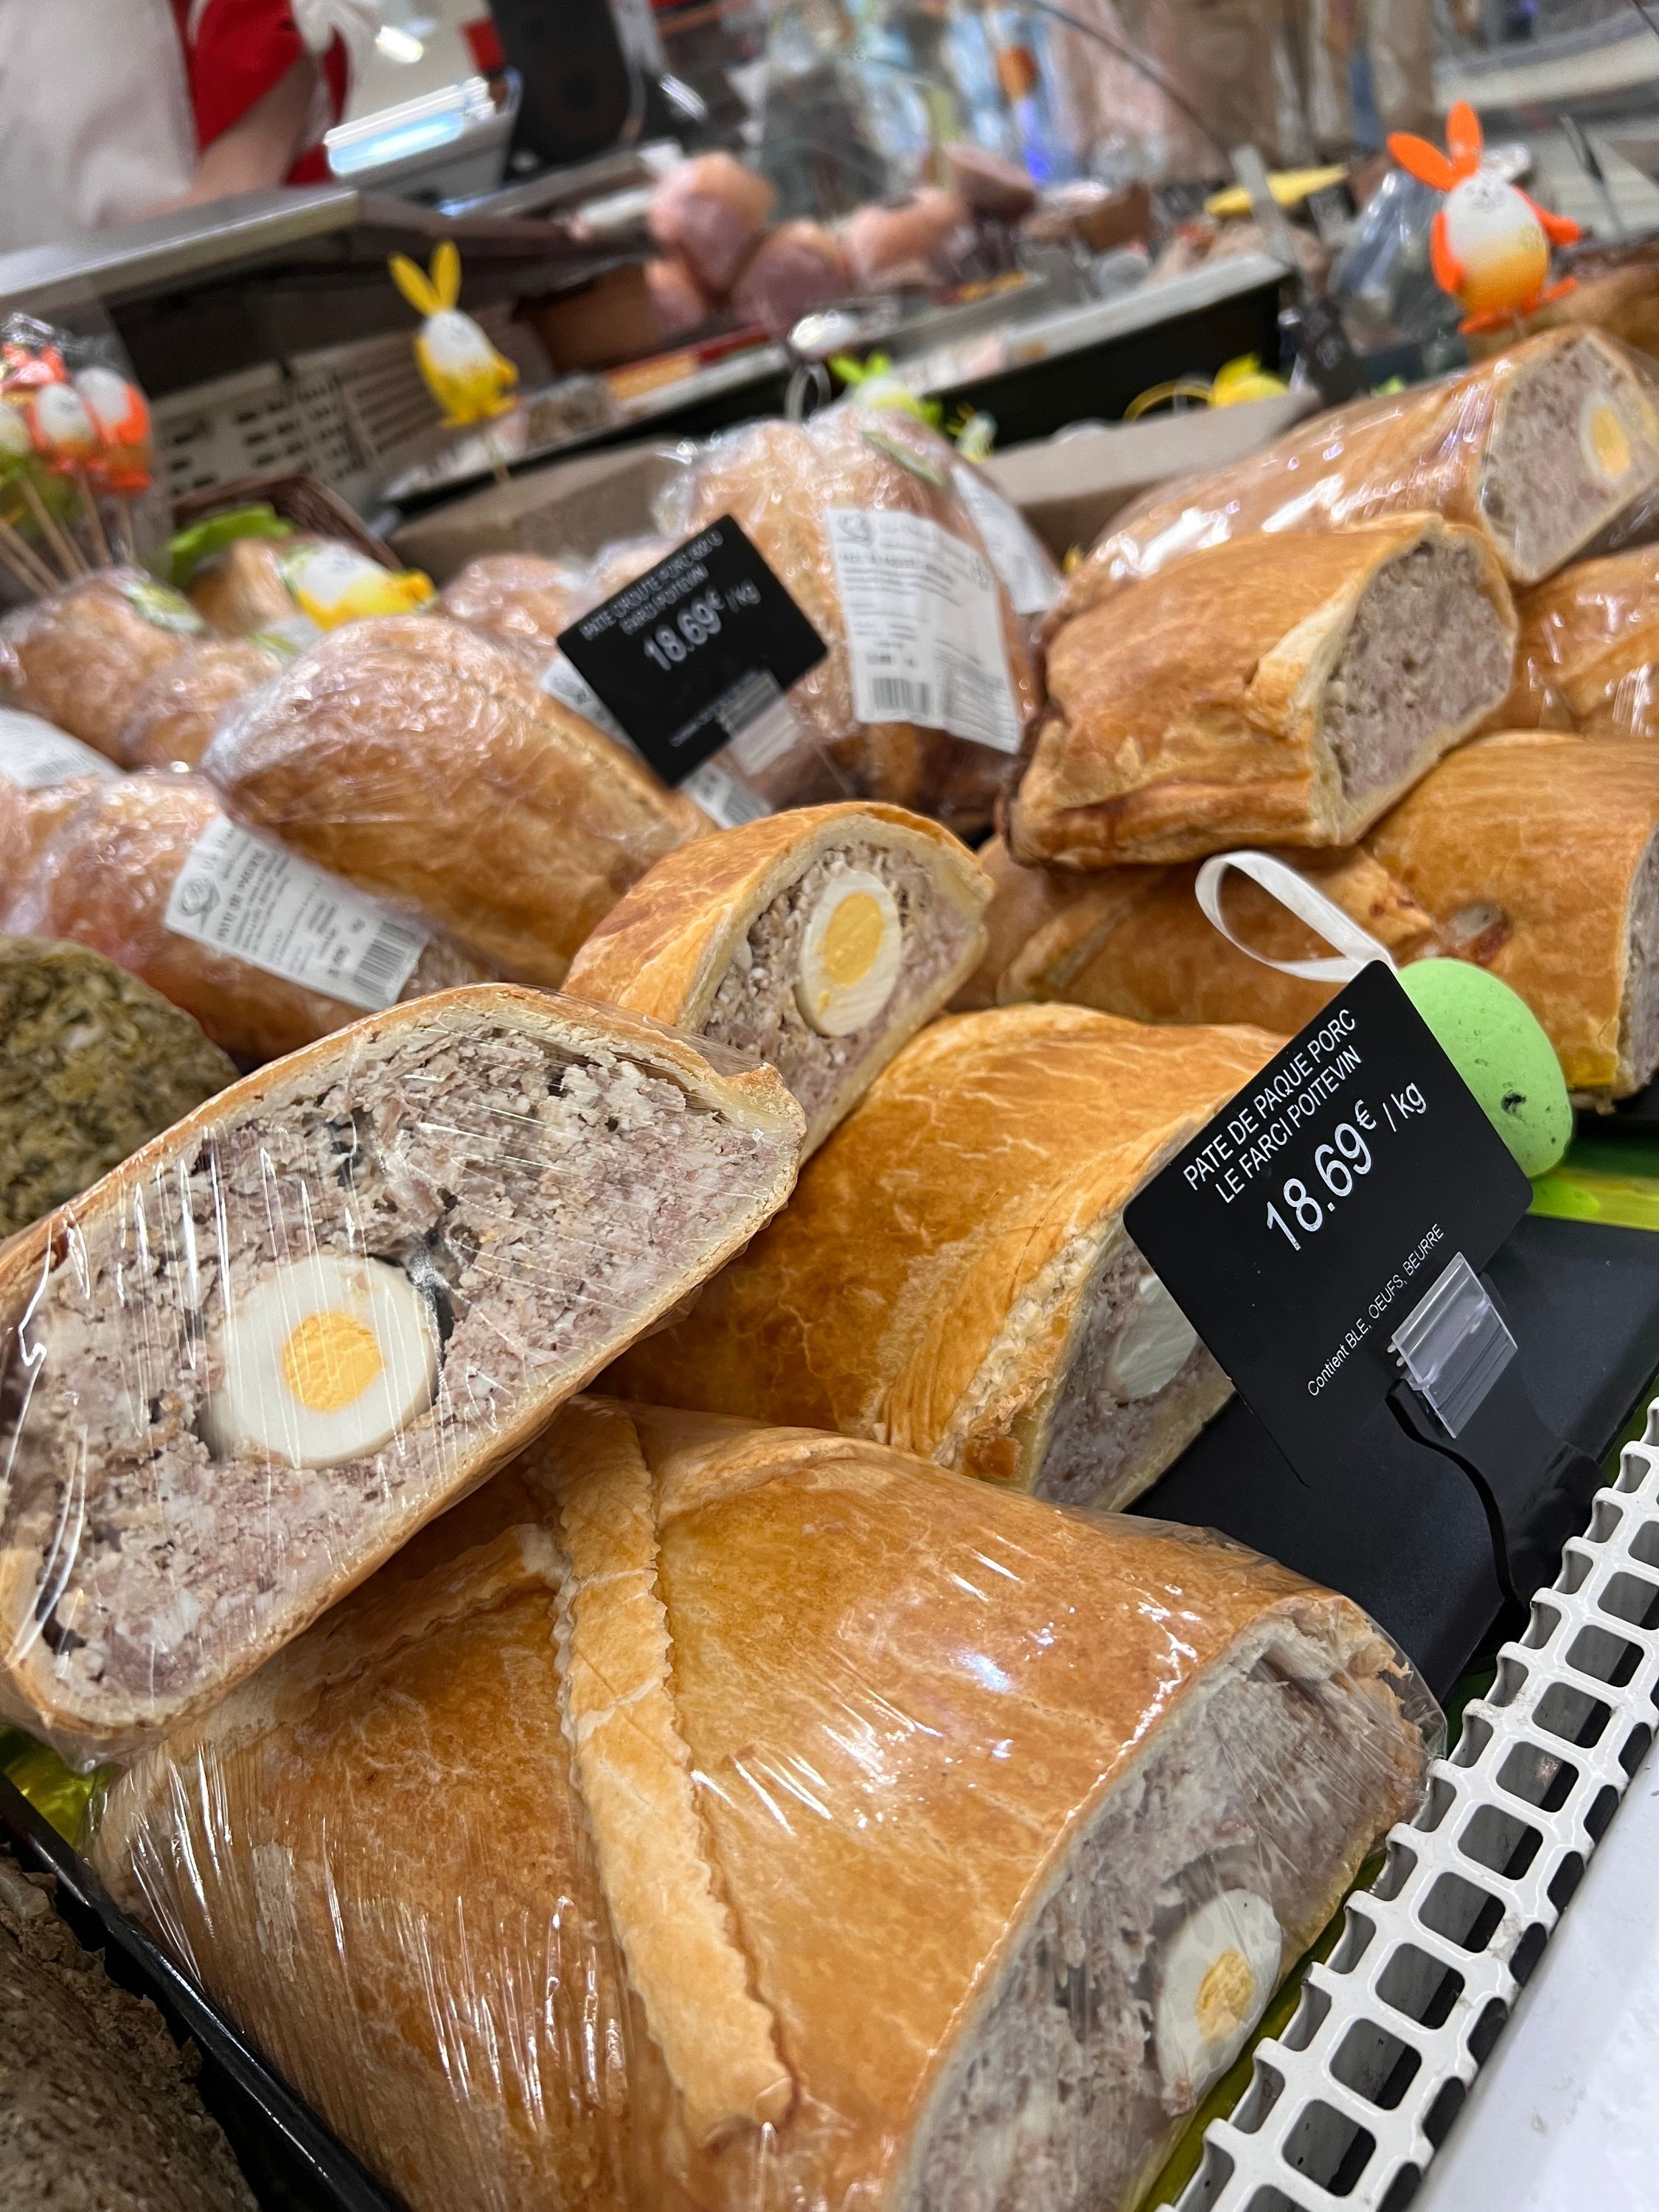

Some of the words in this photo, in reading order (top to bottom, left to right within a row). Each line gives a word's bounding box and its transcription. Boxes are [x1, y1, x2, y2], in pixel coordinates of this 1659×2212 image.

[1183, 1134, 1234, 1191] PATE
[1227, 1107, 1259, 1145] DE
[1253, 1052, 1313, 1119] PAQUE
[1307, 1009, 1356, 1063] PORC
[1215, 1167, 1245, 1203] LE
[1238, 1117, 1293, 1179] FARCI
[1287, 1044, 1362, 1129] POITEVIN
[1382, 1102, 1397, 1133] /
[1390, 1082, 1427, 1119] kg
[1307, 1343, 1349, 1397] Contient
[1344, 1318, 1373, 1349] BLE,
[1368, 1274, 1408, 1320] OEUFS,
[1402, 1223, 1444, 1276] BEURRE
